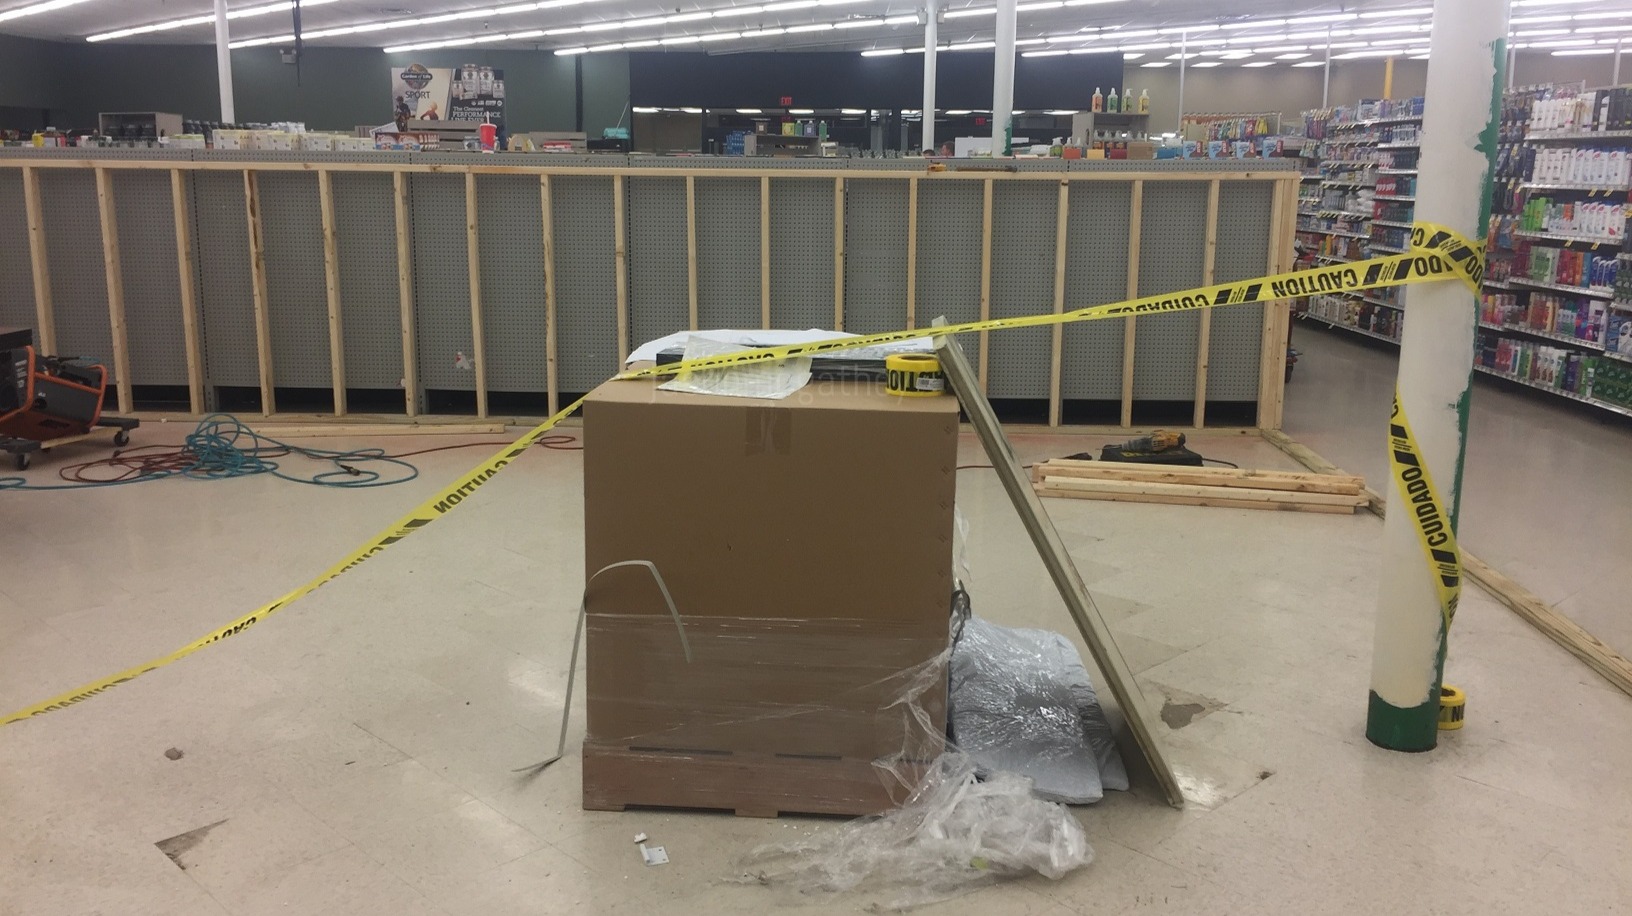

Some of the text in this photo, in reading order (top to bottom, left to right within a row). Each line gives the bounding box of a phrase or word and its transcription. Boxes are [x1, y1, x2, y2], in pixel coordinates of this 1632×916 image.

[405, 90, 431, 99] SPORT
[1271, 268, 1359, 298] CAUTION
[1401, 466, 1449, 548] CUIDADO
